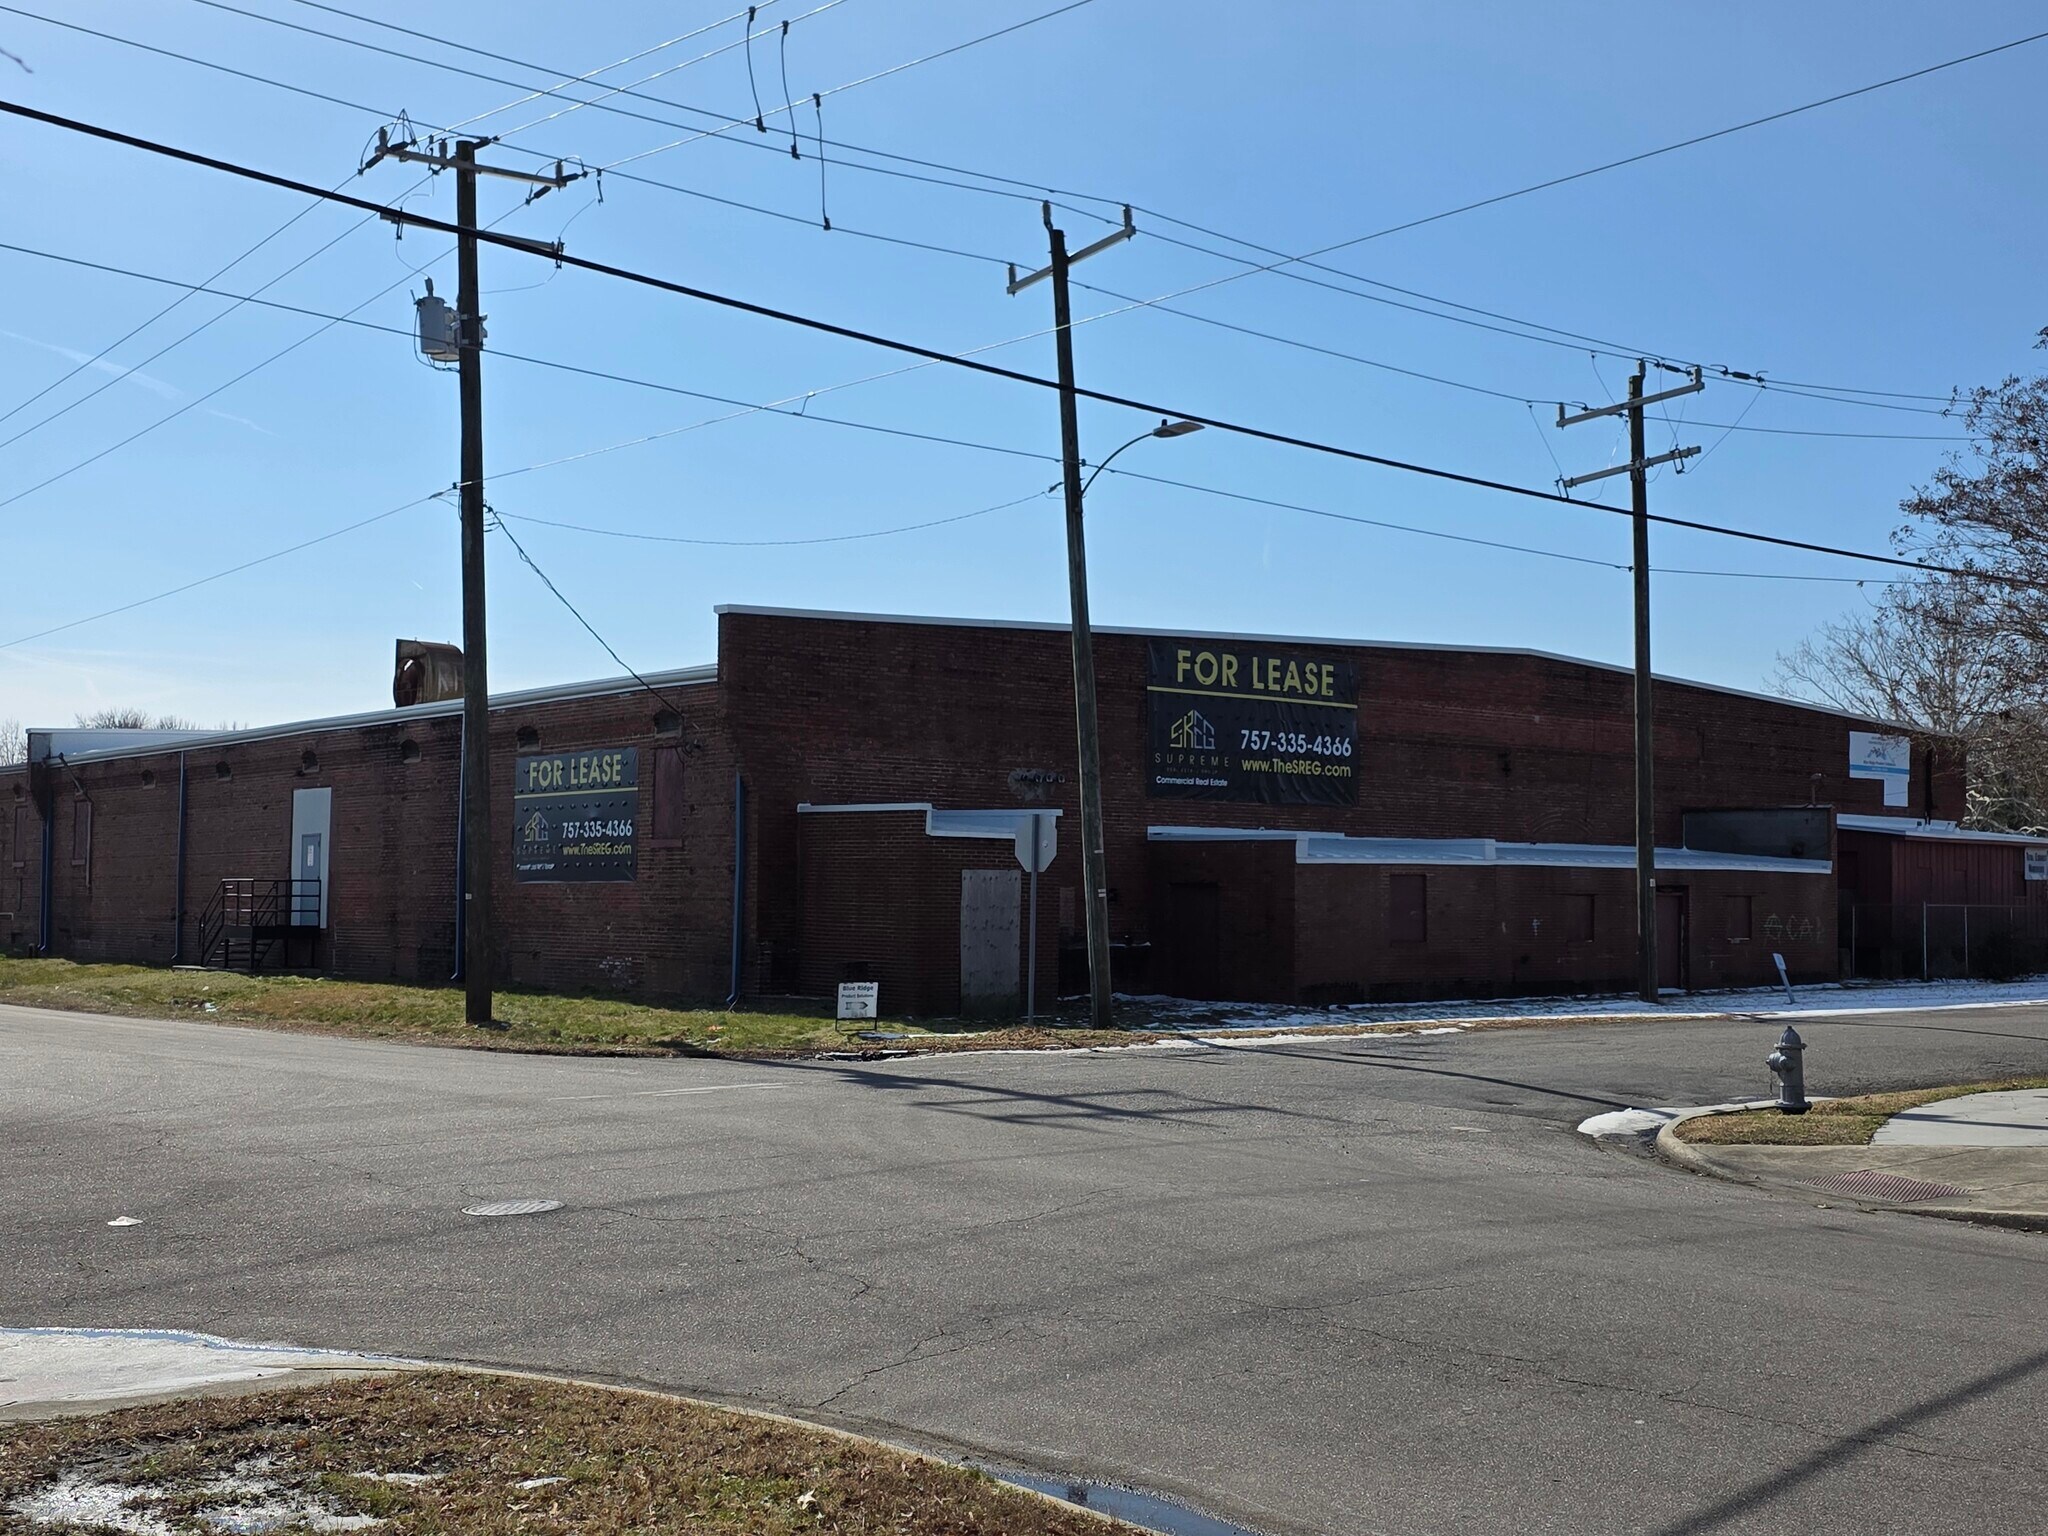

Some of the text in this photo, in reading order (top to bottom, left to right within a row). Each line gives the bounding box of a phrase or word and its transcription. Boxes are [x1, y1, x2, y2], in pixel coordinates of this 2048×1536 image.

[1177, 649, 1334, 696] FOR LEASE
[1240, 729, 1352, 757] 757-335-4366
[1155, 752, 1229, 767] SUPREME
[1241, 758, 1351, 777] www.TheSREG.com
[529, 754, 622, 788] FOR LEASE
[1155, 775, 1195, 785] Commercial
[1210, 778, 1228, 787] Estate
[562, 819, 633, 839] 757-335-4366
[857, 984, 874, 992] Ridge
